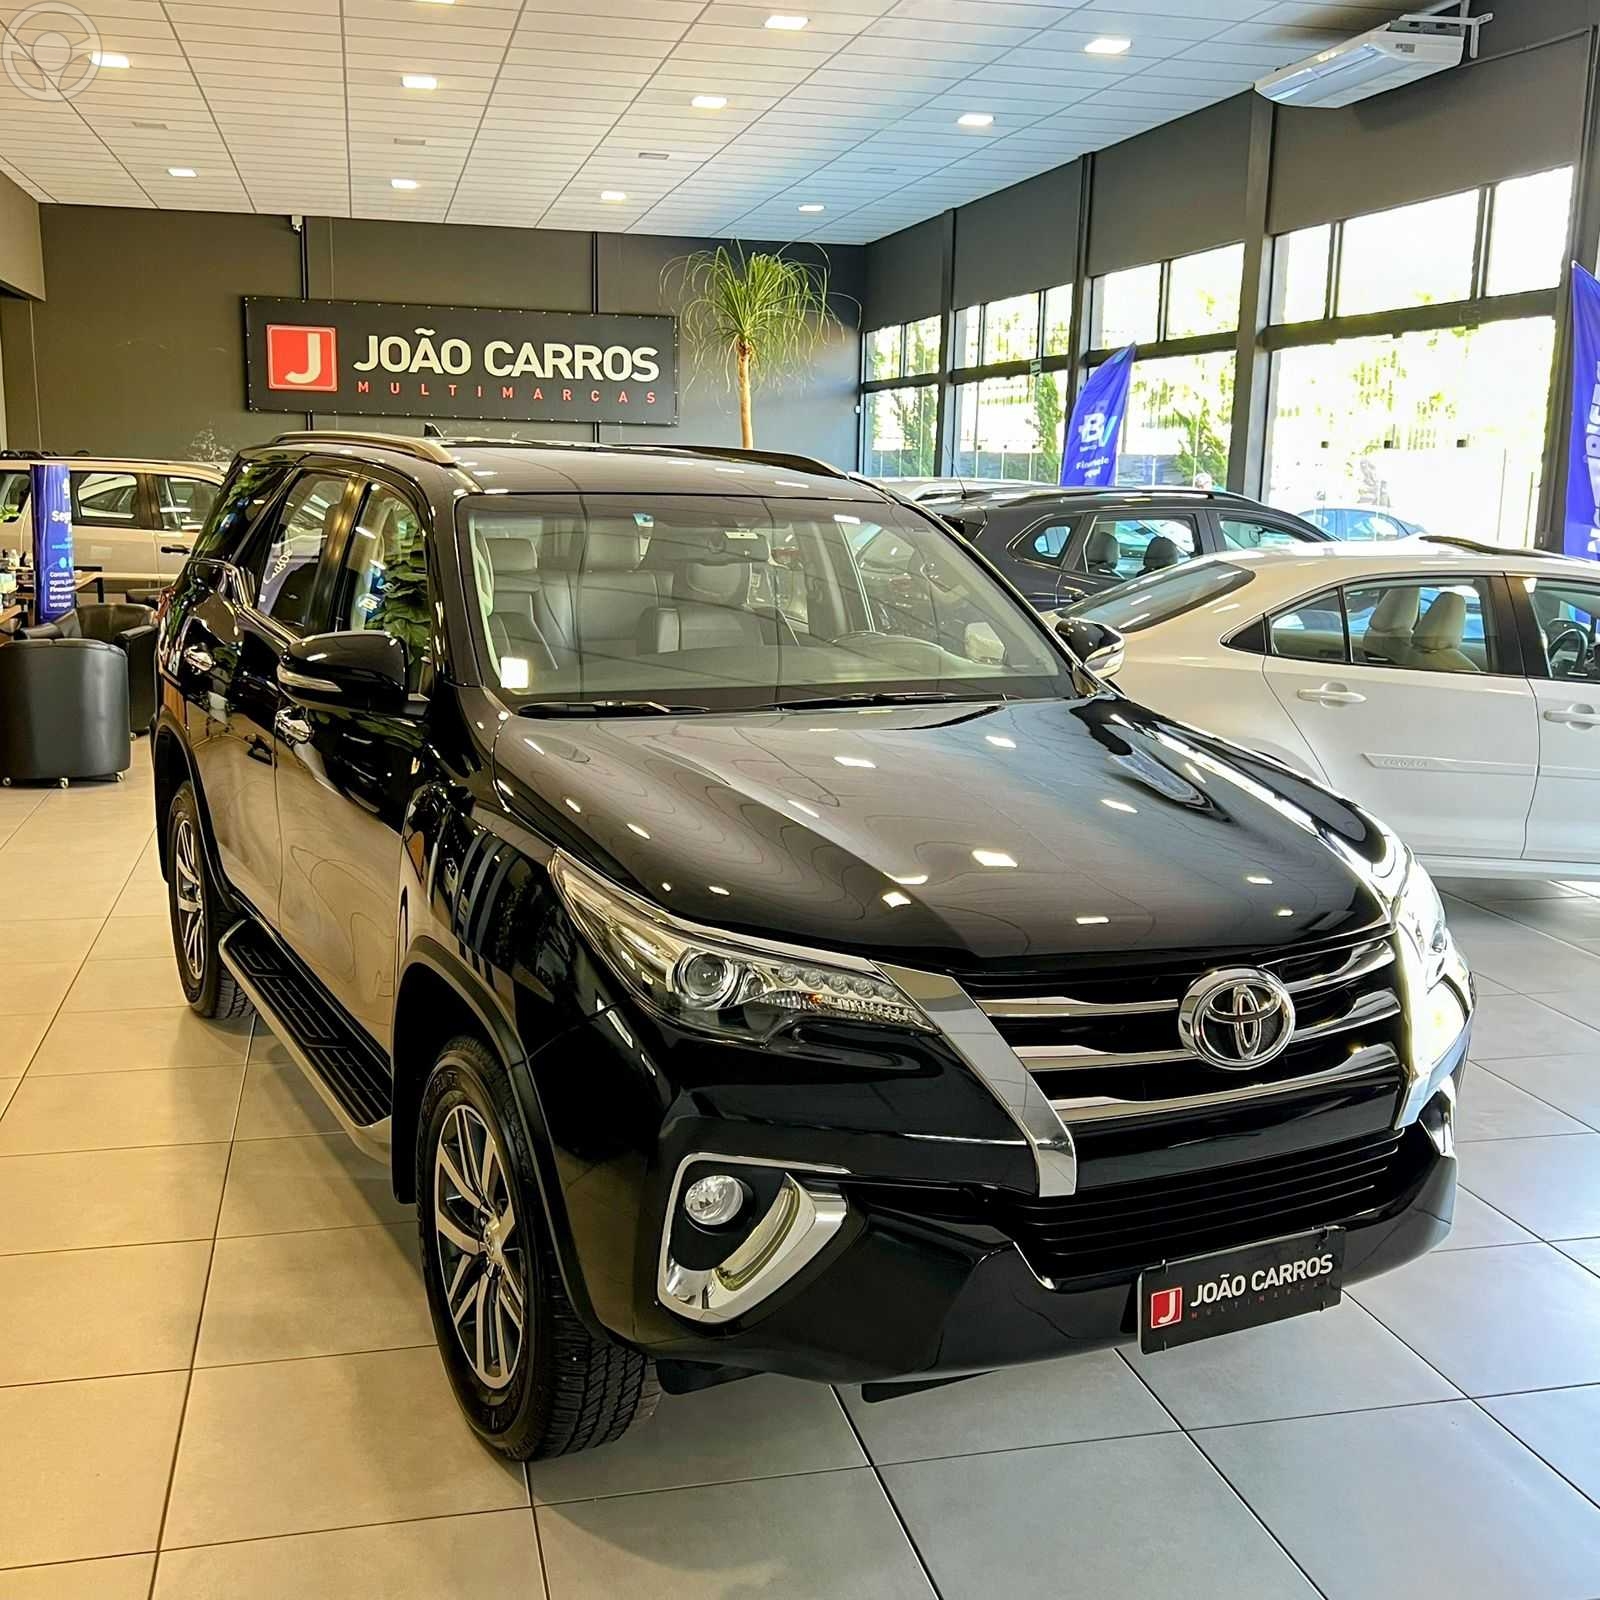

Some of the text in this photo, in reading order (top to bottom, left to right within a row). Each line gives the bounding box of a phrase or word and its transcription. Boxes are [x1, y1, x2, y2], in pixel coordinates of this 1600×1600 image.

[284, 332, 322, 385] J
[353, 327, 660, 383] JOÃO CARROS
[357, 381, 657, 404] MULTIMARCAS
[1190, 1253, 1333, 1307] JOÃO CARROS
